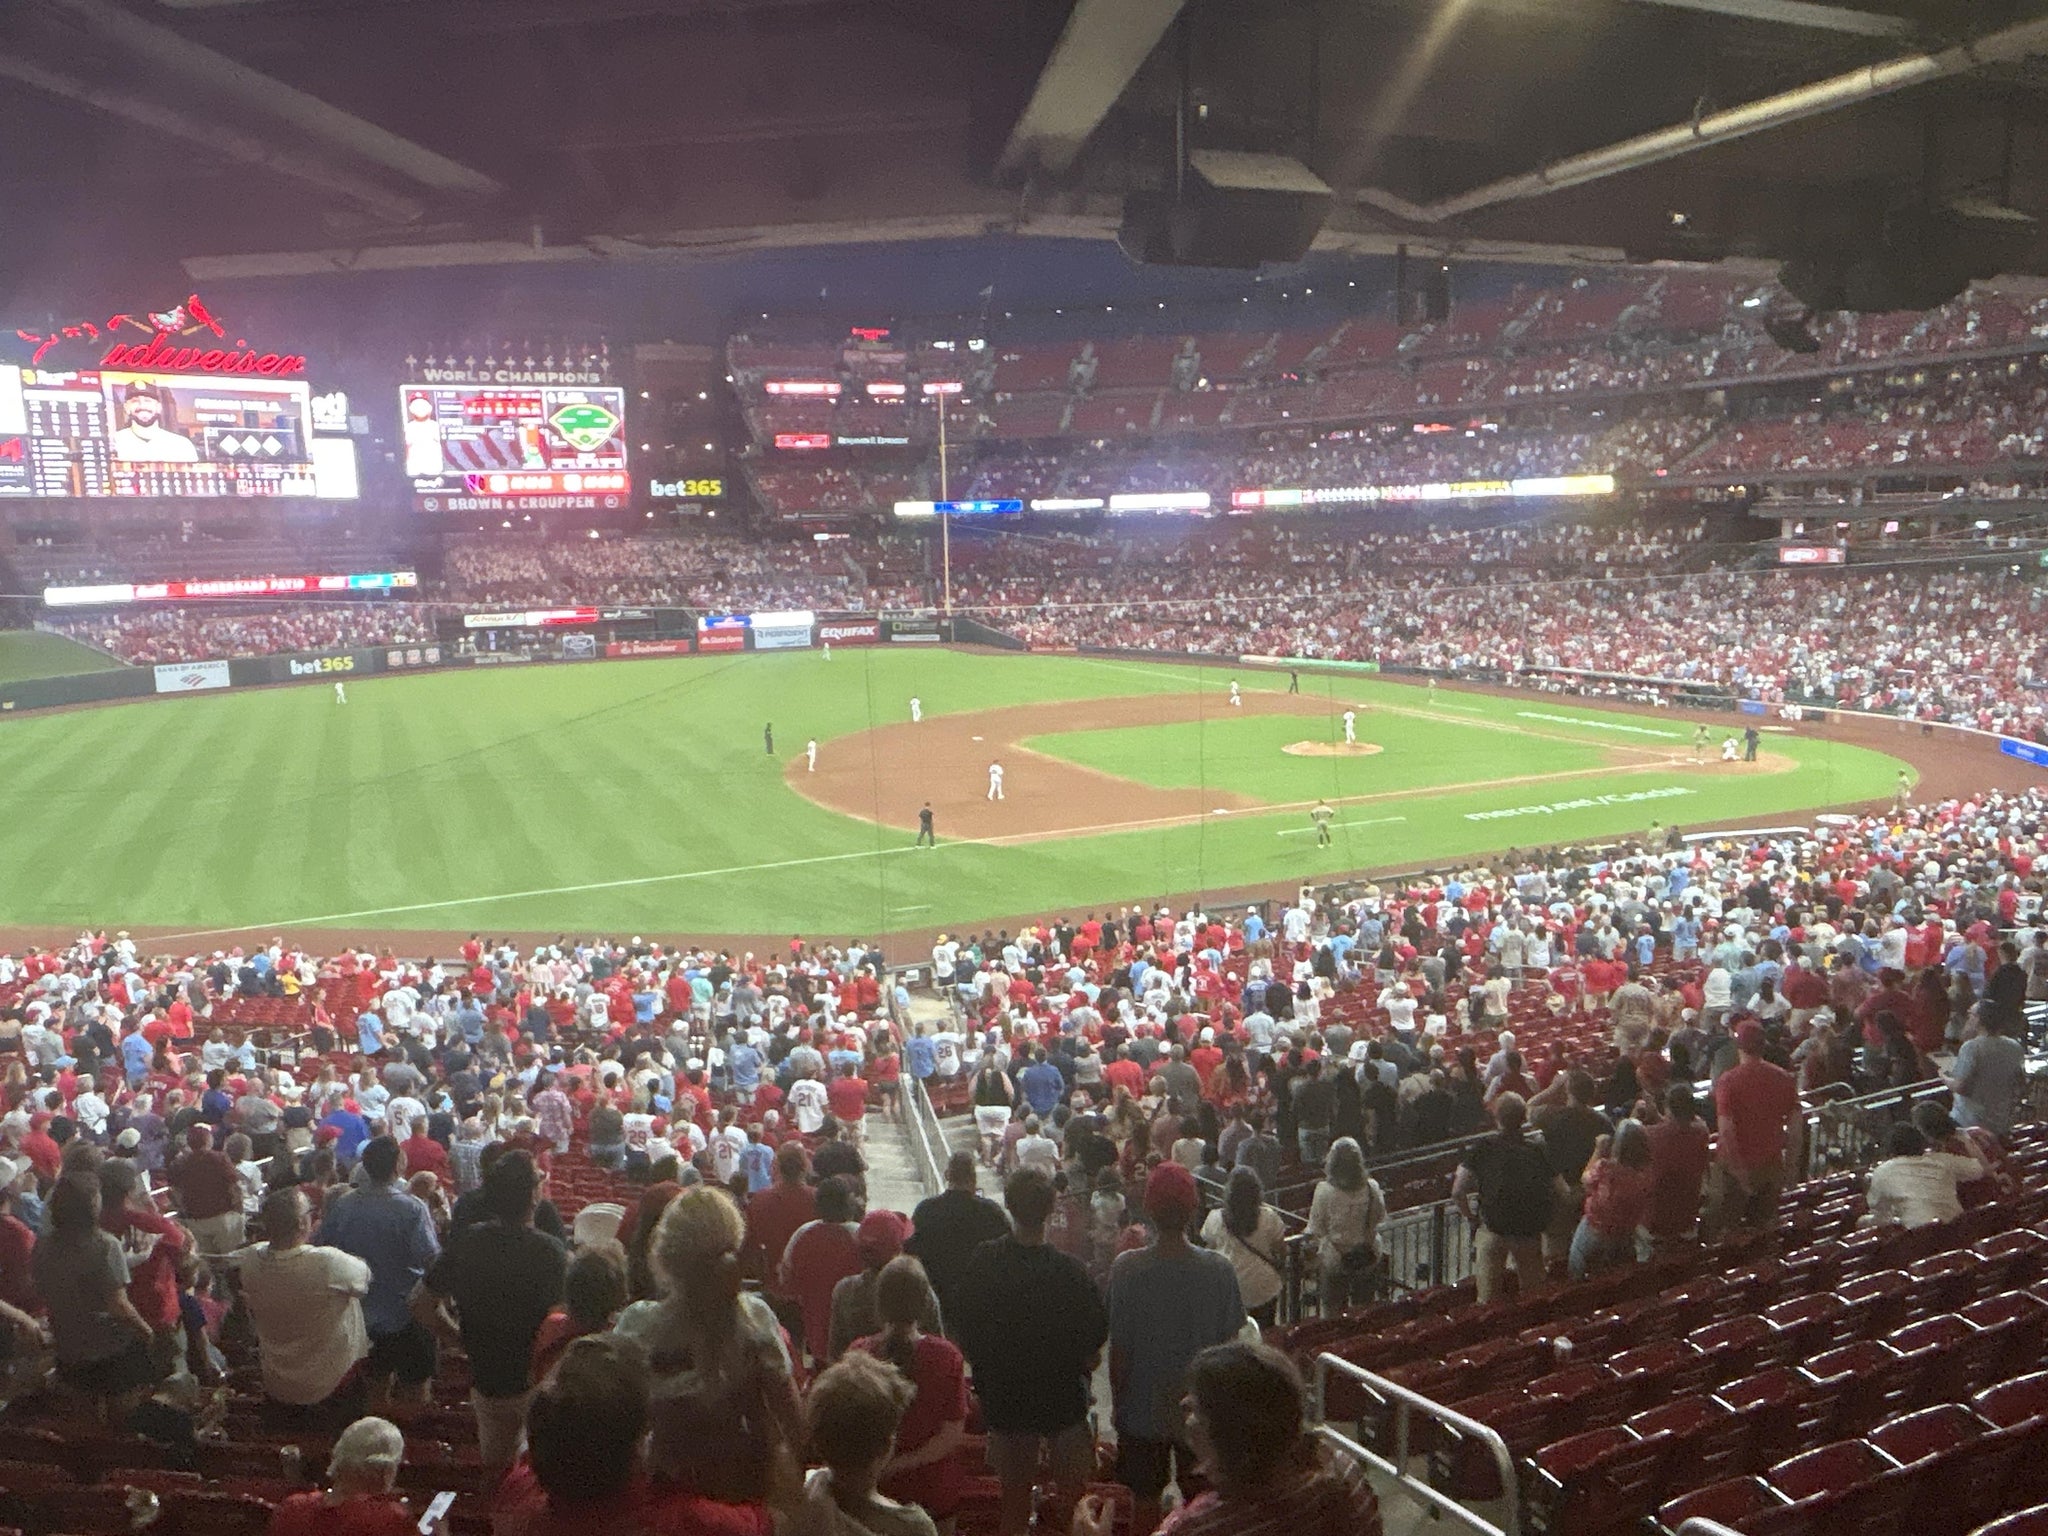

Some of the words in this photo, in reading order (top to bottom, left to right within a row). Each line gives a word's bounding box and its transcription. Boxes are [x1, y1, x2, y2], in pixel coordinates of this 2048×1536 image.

[422, 368, 492, 382] WORLD
[494, 368, 599, 383] CHAMPIONS
[650, 479, 722, 496] bet365
[447, 498, 502, 511] BROWN
[506, 499, 515, 510] &
[819, 626, 875, 641] EQUIFAX
[290, 656, 354, 675] bet365
[798, 1093, 811, 1107] 21
[718, 1144, 732, 1159] 21
